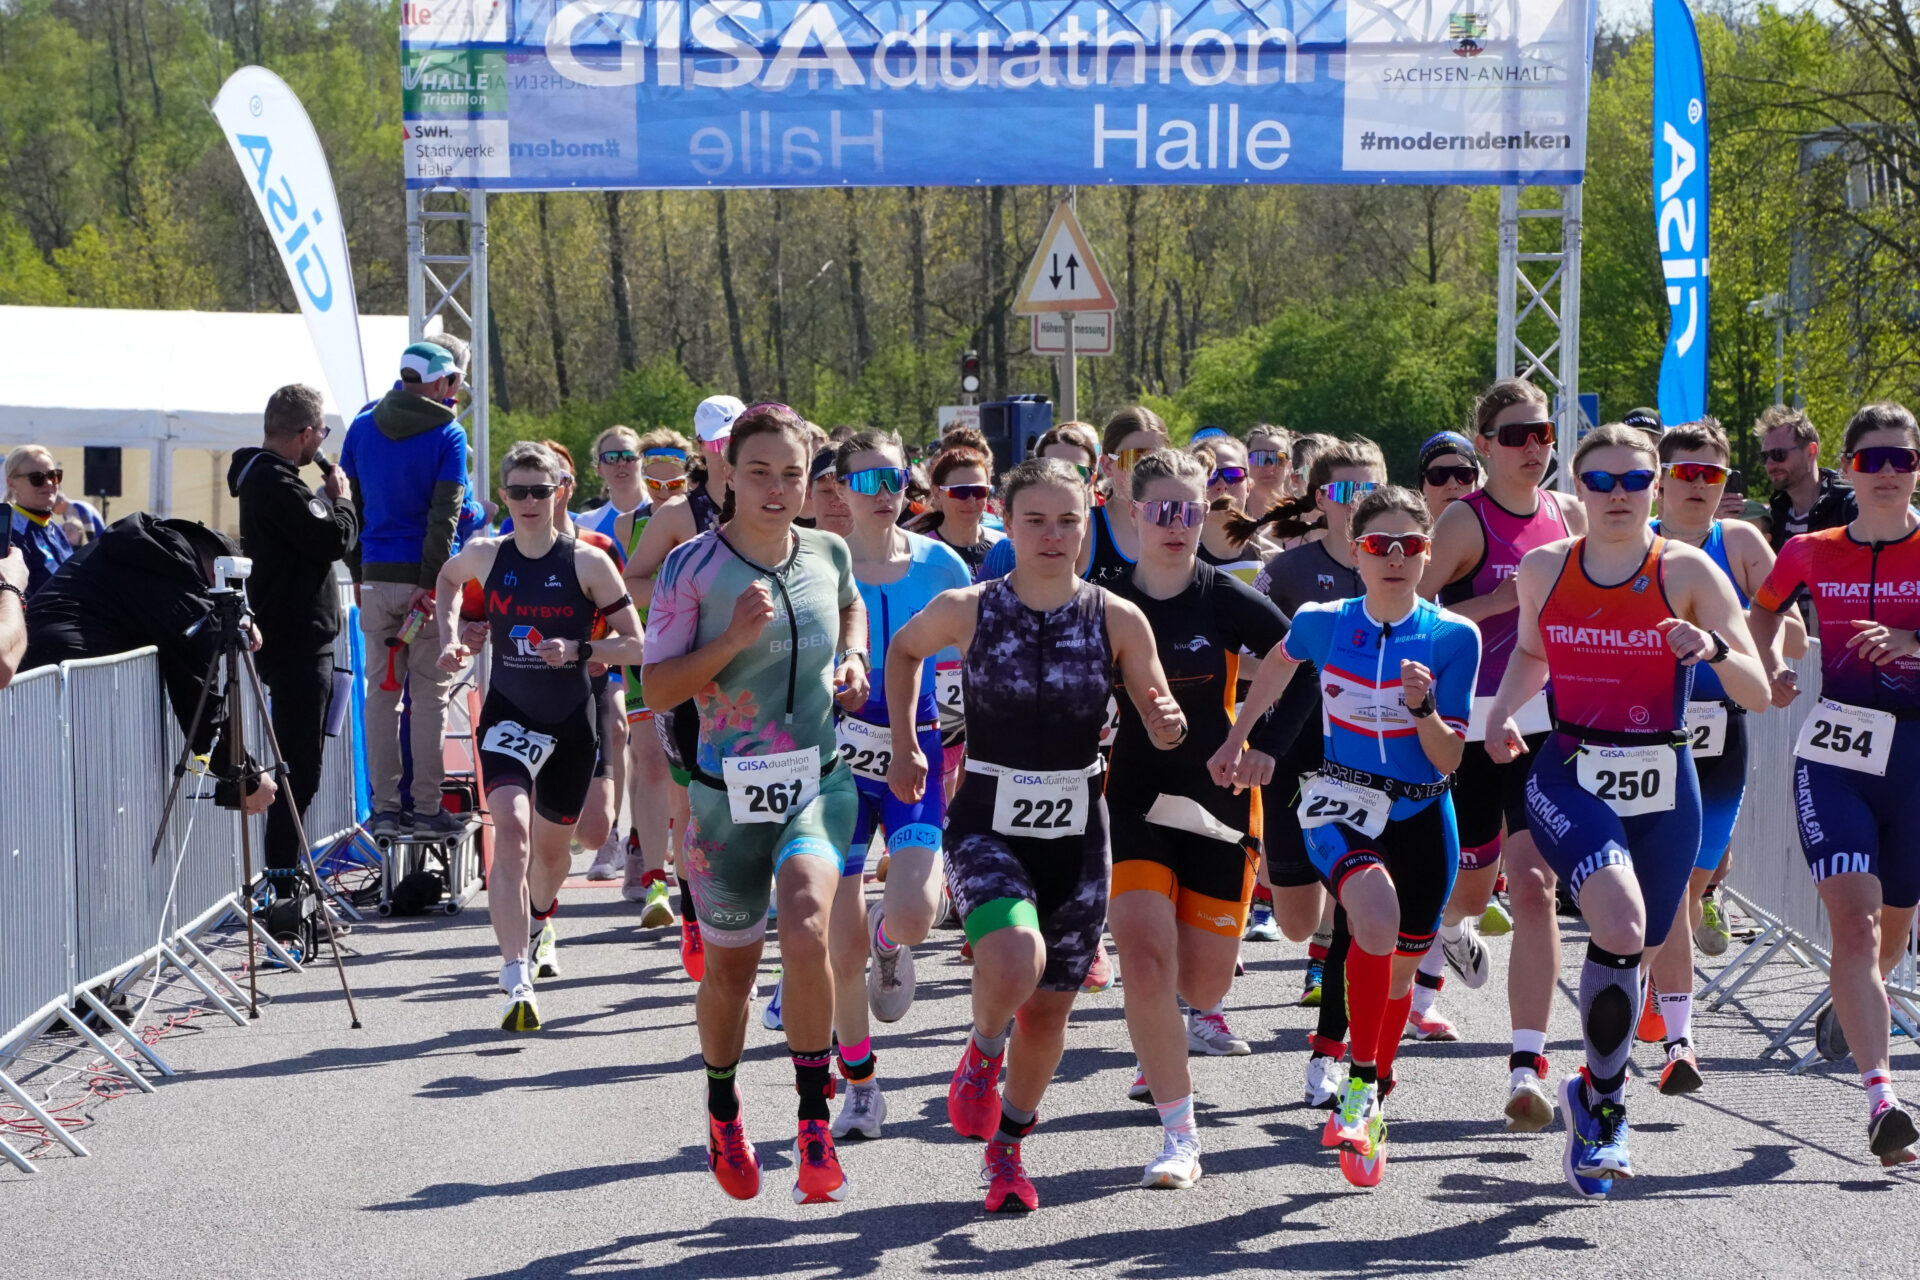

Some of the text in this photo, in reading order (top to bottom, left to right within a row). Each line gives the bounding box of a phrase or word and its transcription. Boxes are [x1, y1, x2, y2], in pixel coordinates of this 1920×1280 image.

[422, 73, 489, 90] HALLE
[1383, 66, 1552, 82] SACHSEN-ANHALT
[422, 92, 487, 105] Triathlon
[415, 125, 453, 138] SWH.
[1093, 103, 1292, 170] Halle
[1360, 131, 1571, 151] #moderndenken
[416, 145, 495, 158] Stadtwerke
[417, 164, 454, 177] Halle
[516, 605, 574, 618] NYBYG
[1056, 639, 1086, 648] BIORACER
[1546, 625, 1662, 648] TRIATHLON
[1573, 647, 1620, 655] INTELLIGENT
[847, 722, 891, 739] GISAduath
[1692, 726, 1711, 750] 2
[1810, 720, 1873, 758] 254
[497, 732, 543, 765] 220
[1600, 749, 1659, 758] GISAduathlon
[737, 756, 809, 771] GISAduathlon
[840, 743, 892, 777] 223
[790, 765, 809, 775] Halle
[1013, 774, 1081, 785] GISAduathlon
[1596, 769, 1660, 800] 250
[1358, 795, 1377, 807] Halle
[1011, 798, 1073, 829] 222
[1307, 795, 1369, 828] 224
